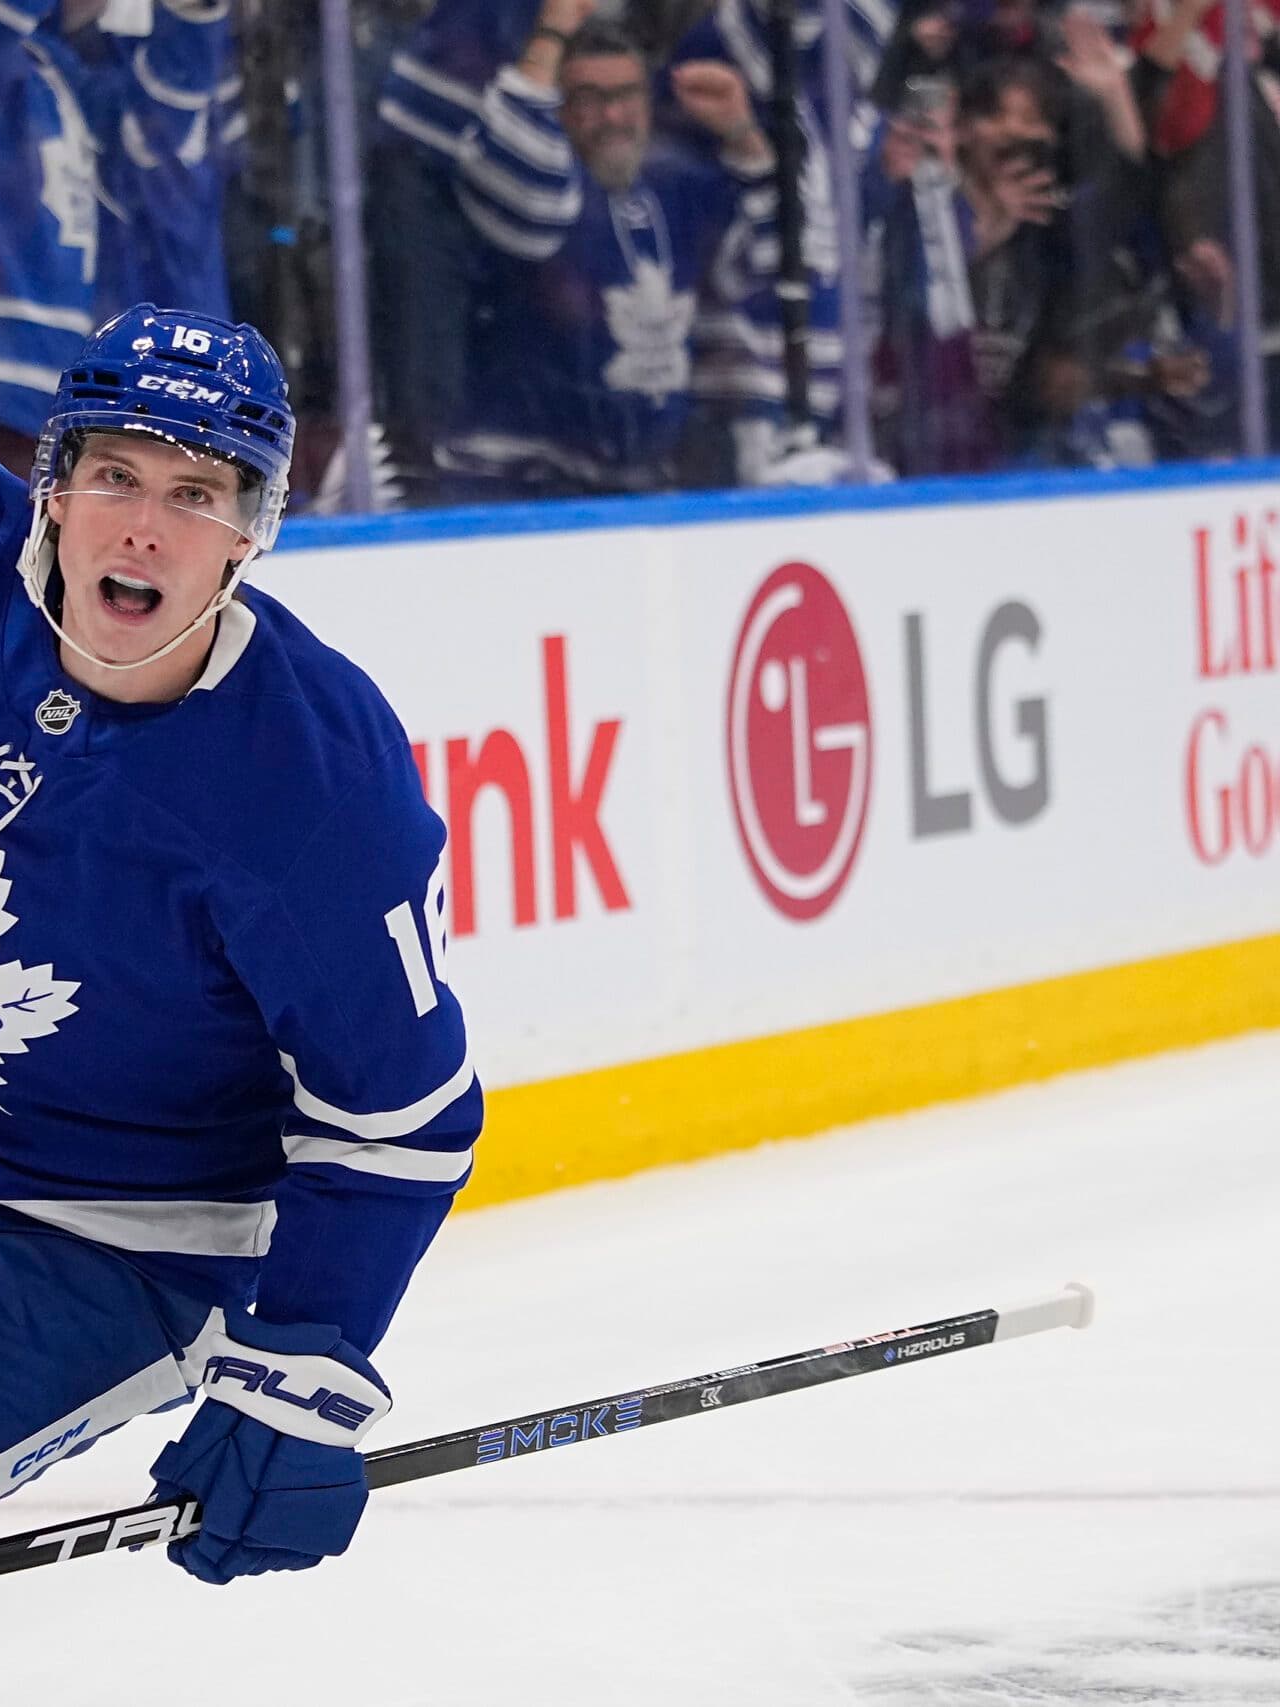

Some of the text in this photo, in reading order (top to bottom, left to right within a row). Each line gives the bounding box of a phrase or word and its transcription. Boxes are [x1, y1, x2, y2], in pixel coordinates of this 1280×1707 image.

[172, 325, 212, 354] 16
[136, 374, 224, 404] CCM
[42, 708, 71, 719] NHL
[902, 599, 1051, 842] LG
[410, 635, 633, 939] nk
[897, 1332, 965, 1359] HZRDUS
[10, 1418, 91, 1479] CCM
[476, 1398, 643, 1465] SMOKE
